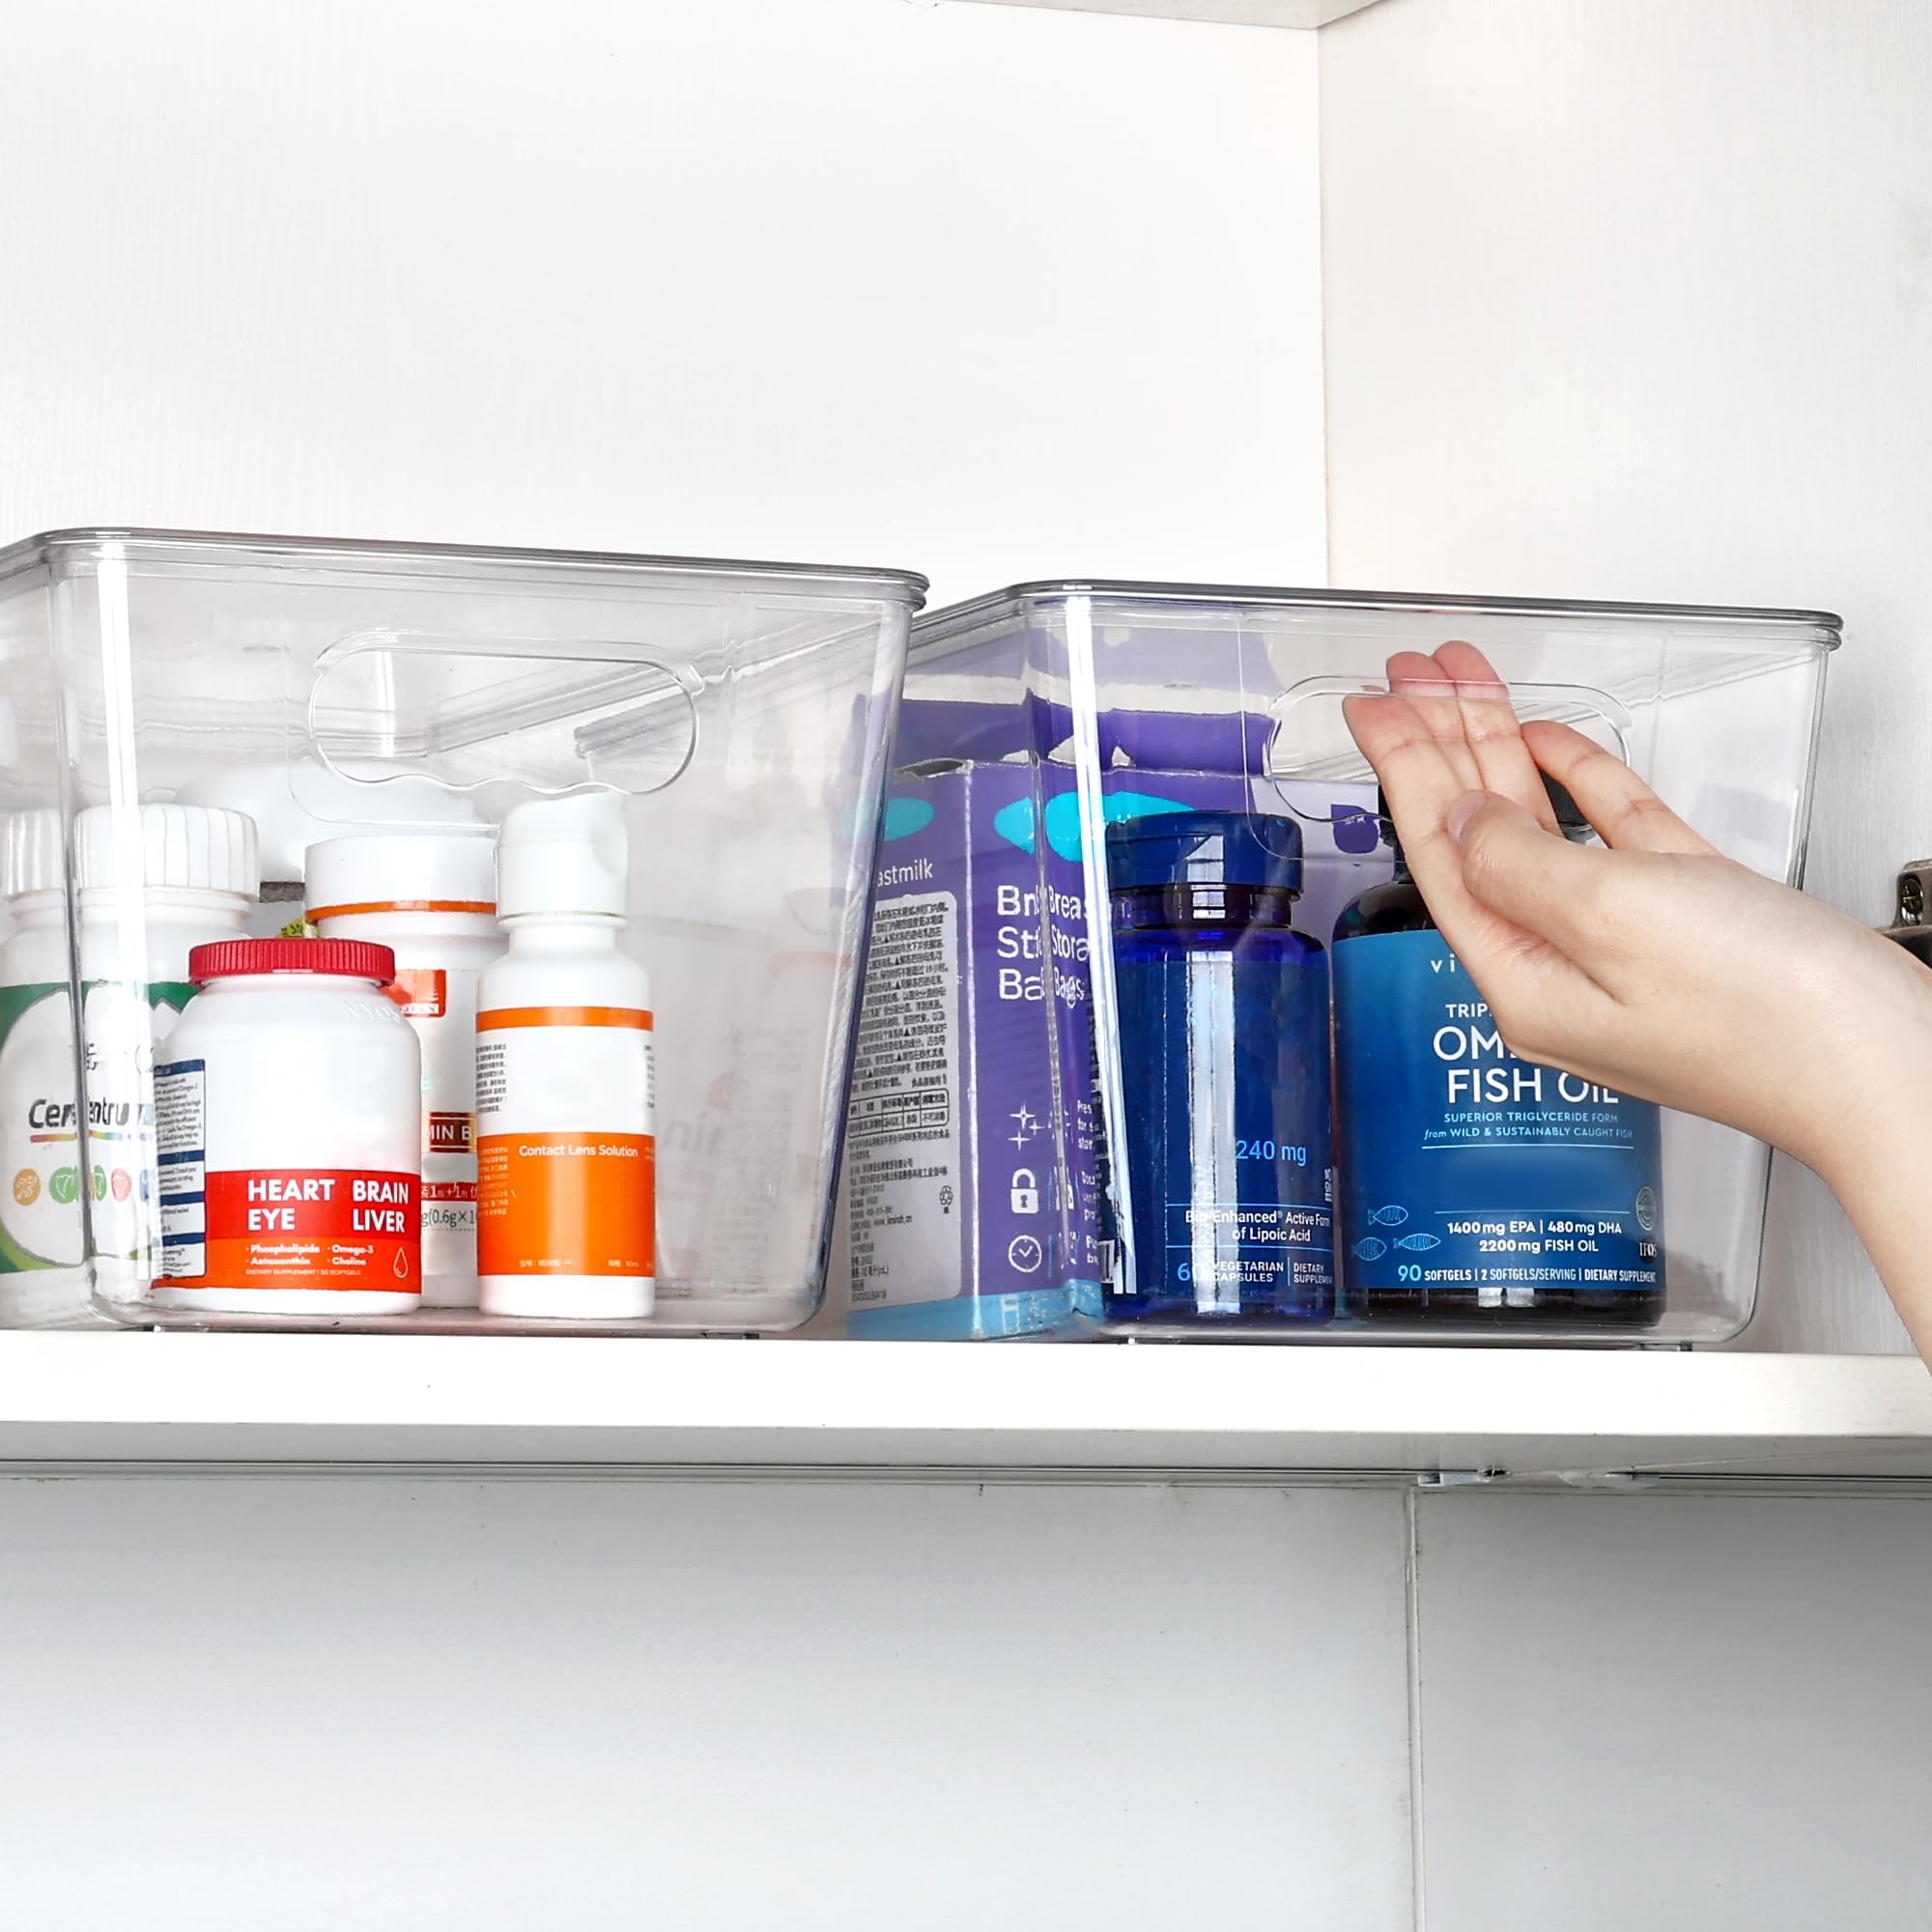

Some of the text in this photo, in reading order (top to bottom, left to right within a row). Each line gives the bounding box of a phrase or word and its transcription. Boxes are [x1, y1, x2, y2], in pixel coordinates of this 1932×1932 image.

[1049, 885, 1085, 920] Brea
[1445, 1003, 1492, 1018] TRIP
[1434, 1025, 1517, 1061] OM
[1448, 1067, 1542, 1103] FISH
[1444, 1111, 1618, 1122] SUPERIOR TRIGLYCERIDE FORM
[1424, 1126, 1633, 1140] from WILD & SUSTAINABLY CAUGHT FISH
[519, 1145, 564, 1156] Contact
[569, 1145, 596, 1156] Lens
[599, 1145, 638, 1157] Solution
[1236, 1140, 1306, 1166] 240 mg
[248, 1179, 409, 1205] HEART BRAIN
[248, 1208, 405, 1233] EYE LIVER
[1286, 1212, 1315, 1226] Active
[1233, 1227, 1311, 1243] of Lipoic Acid
[1510, 1221, 1536, 1234] EPA
[1598, 1222, 1622, 1235] DHA
[250, 1244, 374, 1256] Phospholipids Omega-3
[1545, 1240, 1575, 1252] FISH
[1577, 1240, 1599, 1252] OIL
[250, 1257, 366, 1265] Astaxanthin Choline
[1293, 1263, 1323, 1273] DIETARY
[1398, 1264, 1656, 1284] 90 SOFTGELS 2 SOFTGELS/SERVING DIETARY SUPPLEMENT
